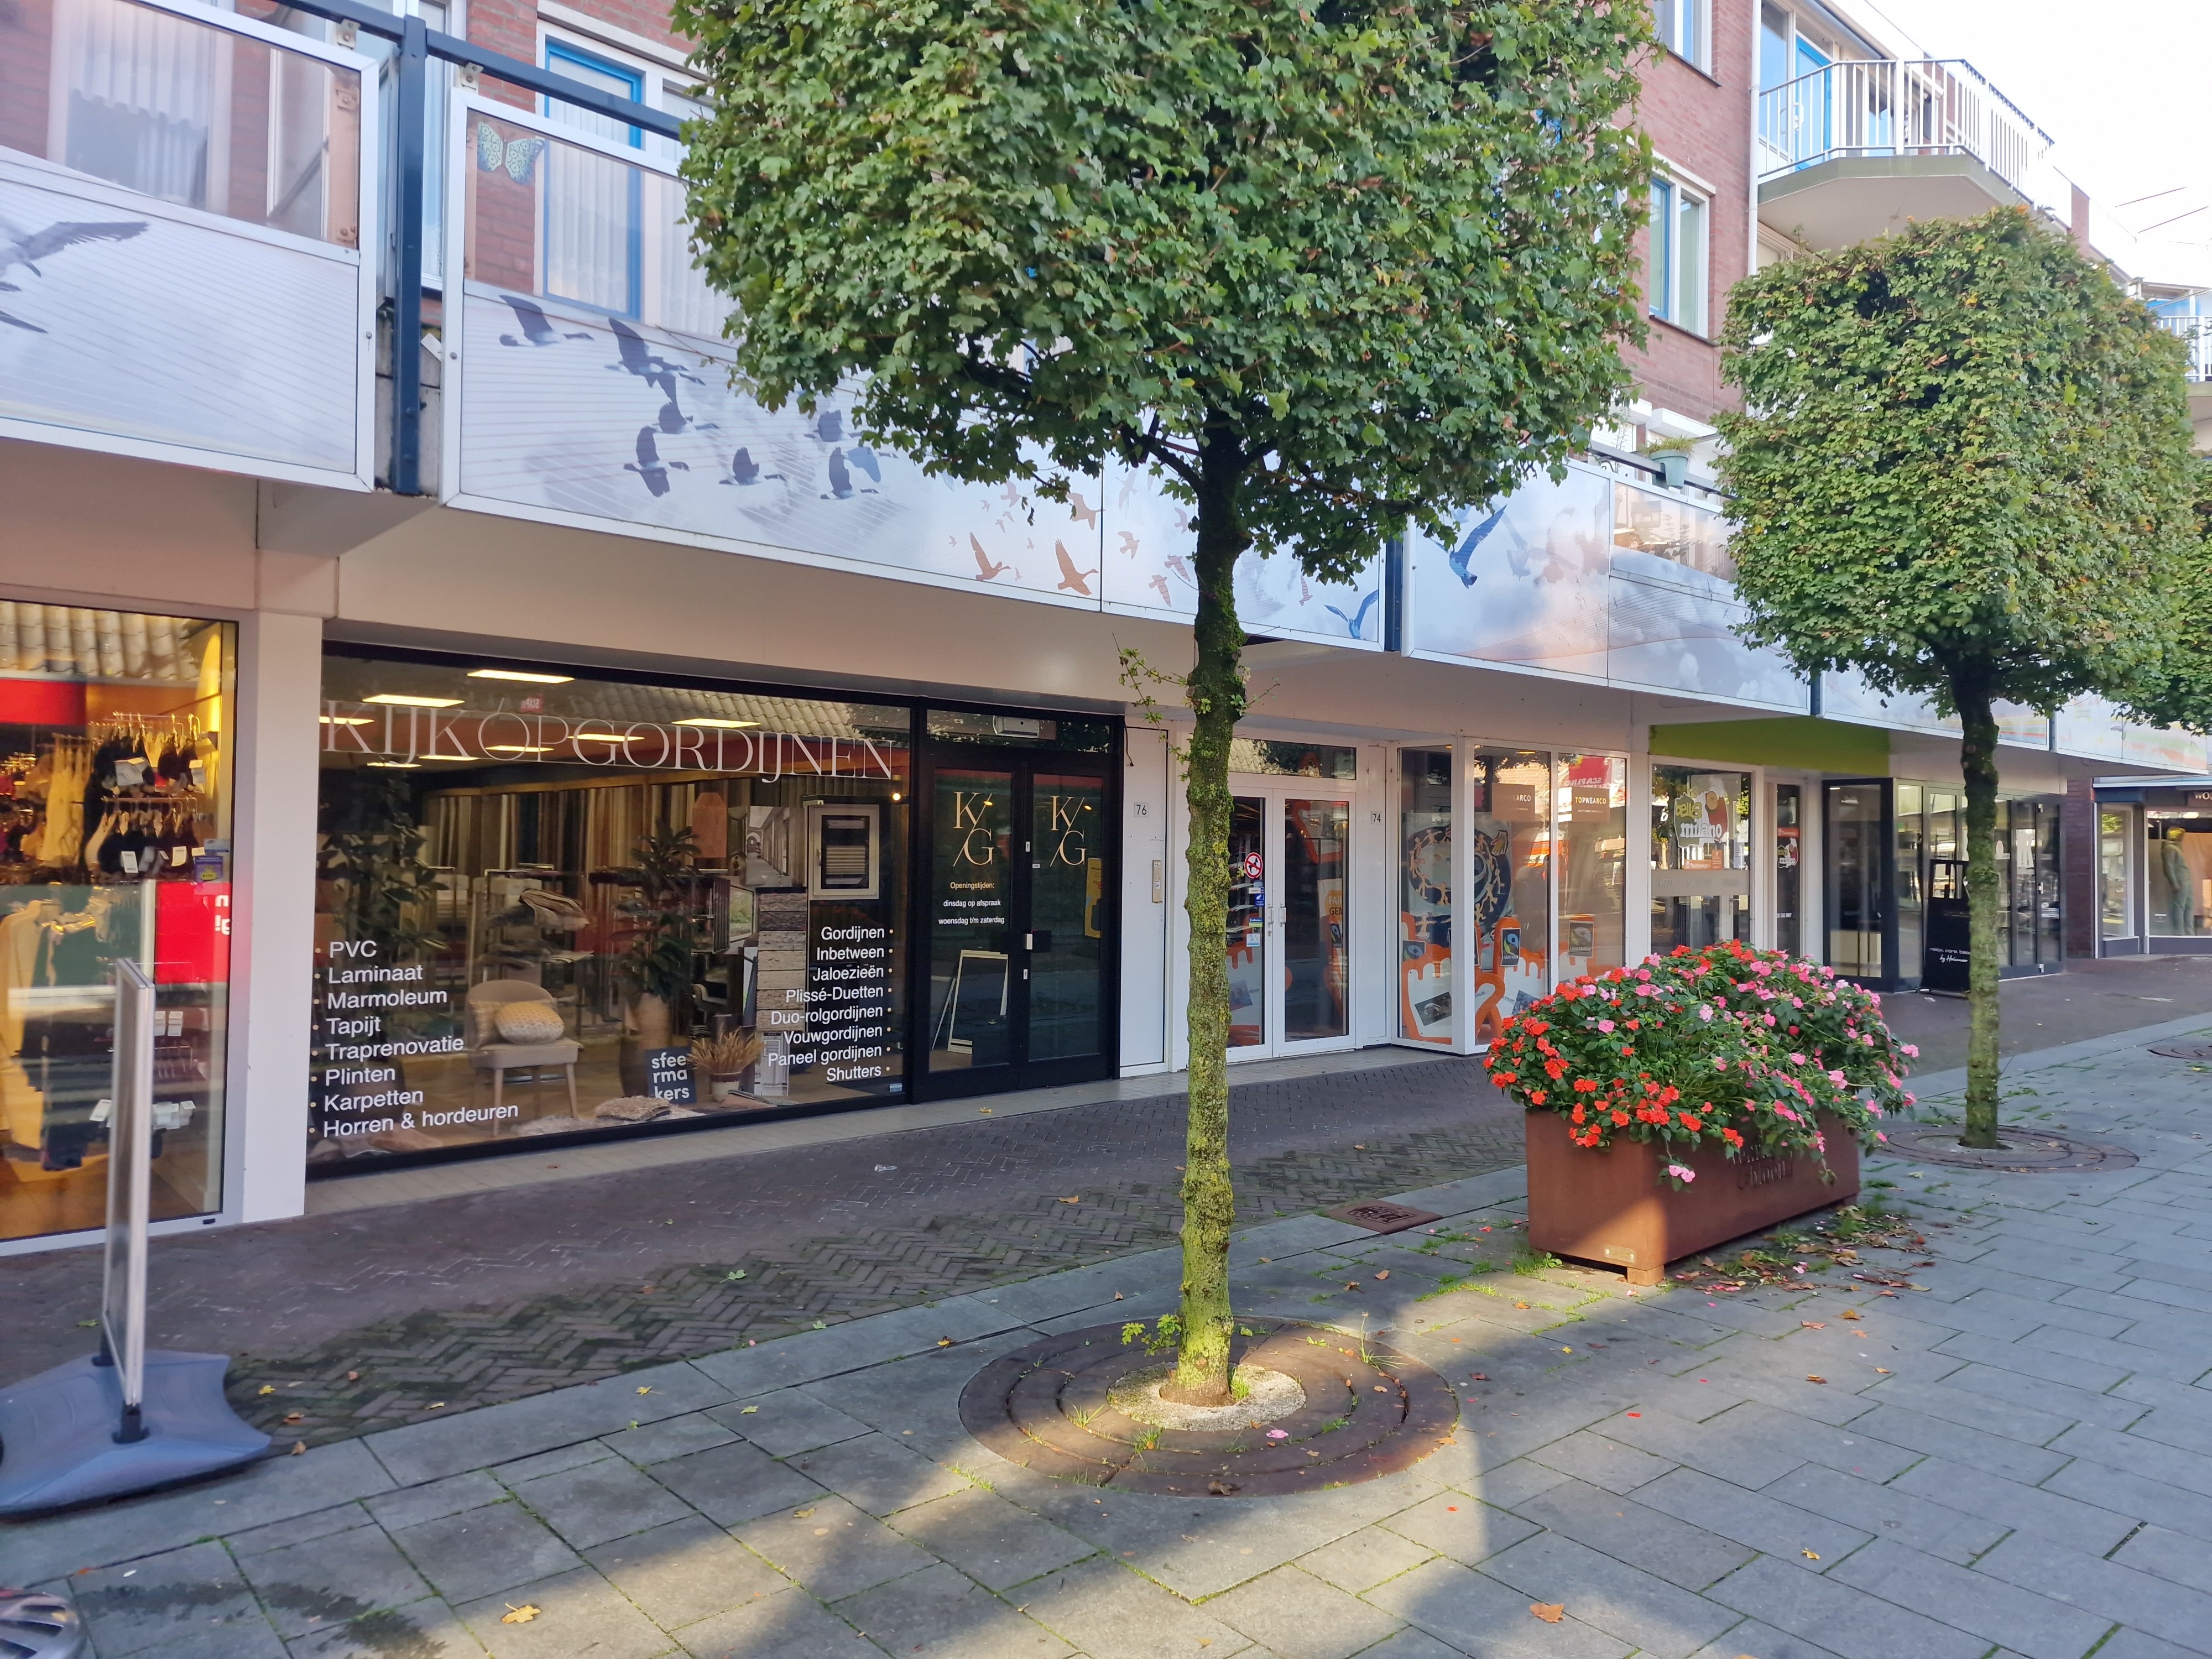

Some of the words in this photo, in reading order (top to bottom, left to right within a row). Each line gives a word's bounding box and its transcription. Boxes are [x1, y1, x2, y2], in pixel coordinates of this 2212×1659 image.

[1575, 796, 1606, 805] TOPWEARCO
[1675, 801, 1703, 819] bella
[1136, 805, 1147, 816] 76
[1372, 813, 1381, 823] 74
[1680, 818, 1723, 839] milano
[950, 881, 995, 890] Openingstijden:
[943, 900, 967, 908] dinsdag
[976, 899, 1001, 907] afspraak
[938, 917, 968, 925] woensdag
[980, 916, 1005, 924] zaterdag
[820, 926, 885, 942] Gordijnen
[329, 940, 377, 959] PVC
[816, 946, 885, 961] Inbetween
[328, 964, 424, 984] Laminaat
[812, 966, 884, 982] Jaloezieën
[327, 988, 447, 1010] Marmoleum
[785, 985, 884, 1004] Plissé-Duetten
[771, 1005, 883, 1026] Duo-rolgordijnen
[326, 1015, 381, 1036] Tapijt
[783, 1025, 883, 1046] Vouwgordijnen
[325, 1036, 465, 1061] Traprenovatie
[768, 1049, 817, 1068] Paneel
[820, 1045, 882, 1066] gordijnen
[325, 1067, 396, 1087] Plinten
[653, 1068, 687, 1082] rma
[826, 1064, 882, 1083] Shutters
[324, 1087, 424, 1114] Karpetten
[654, 1083, 690, 1101] kers
[323, 1118, 394, 1138] Horren
[401, 1112, 415, 1129] &
[421, 1104, 519, 1128] hordeuren
